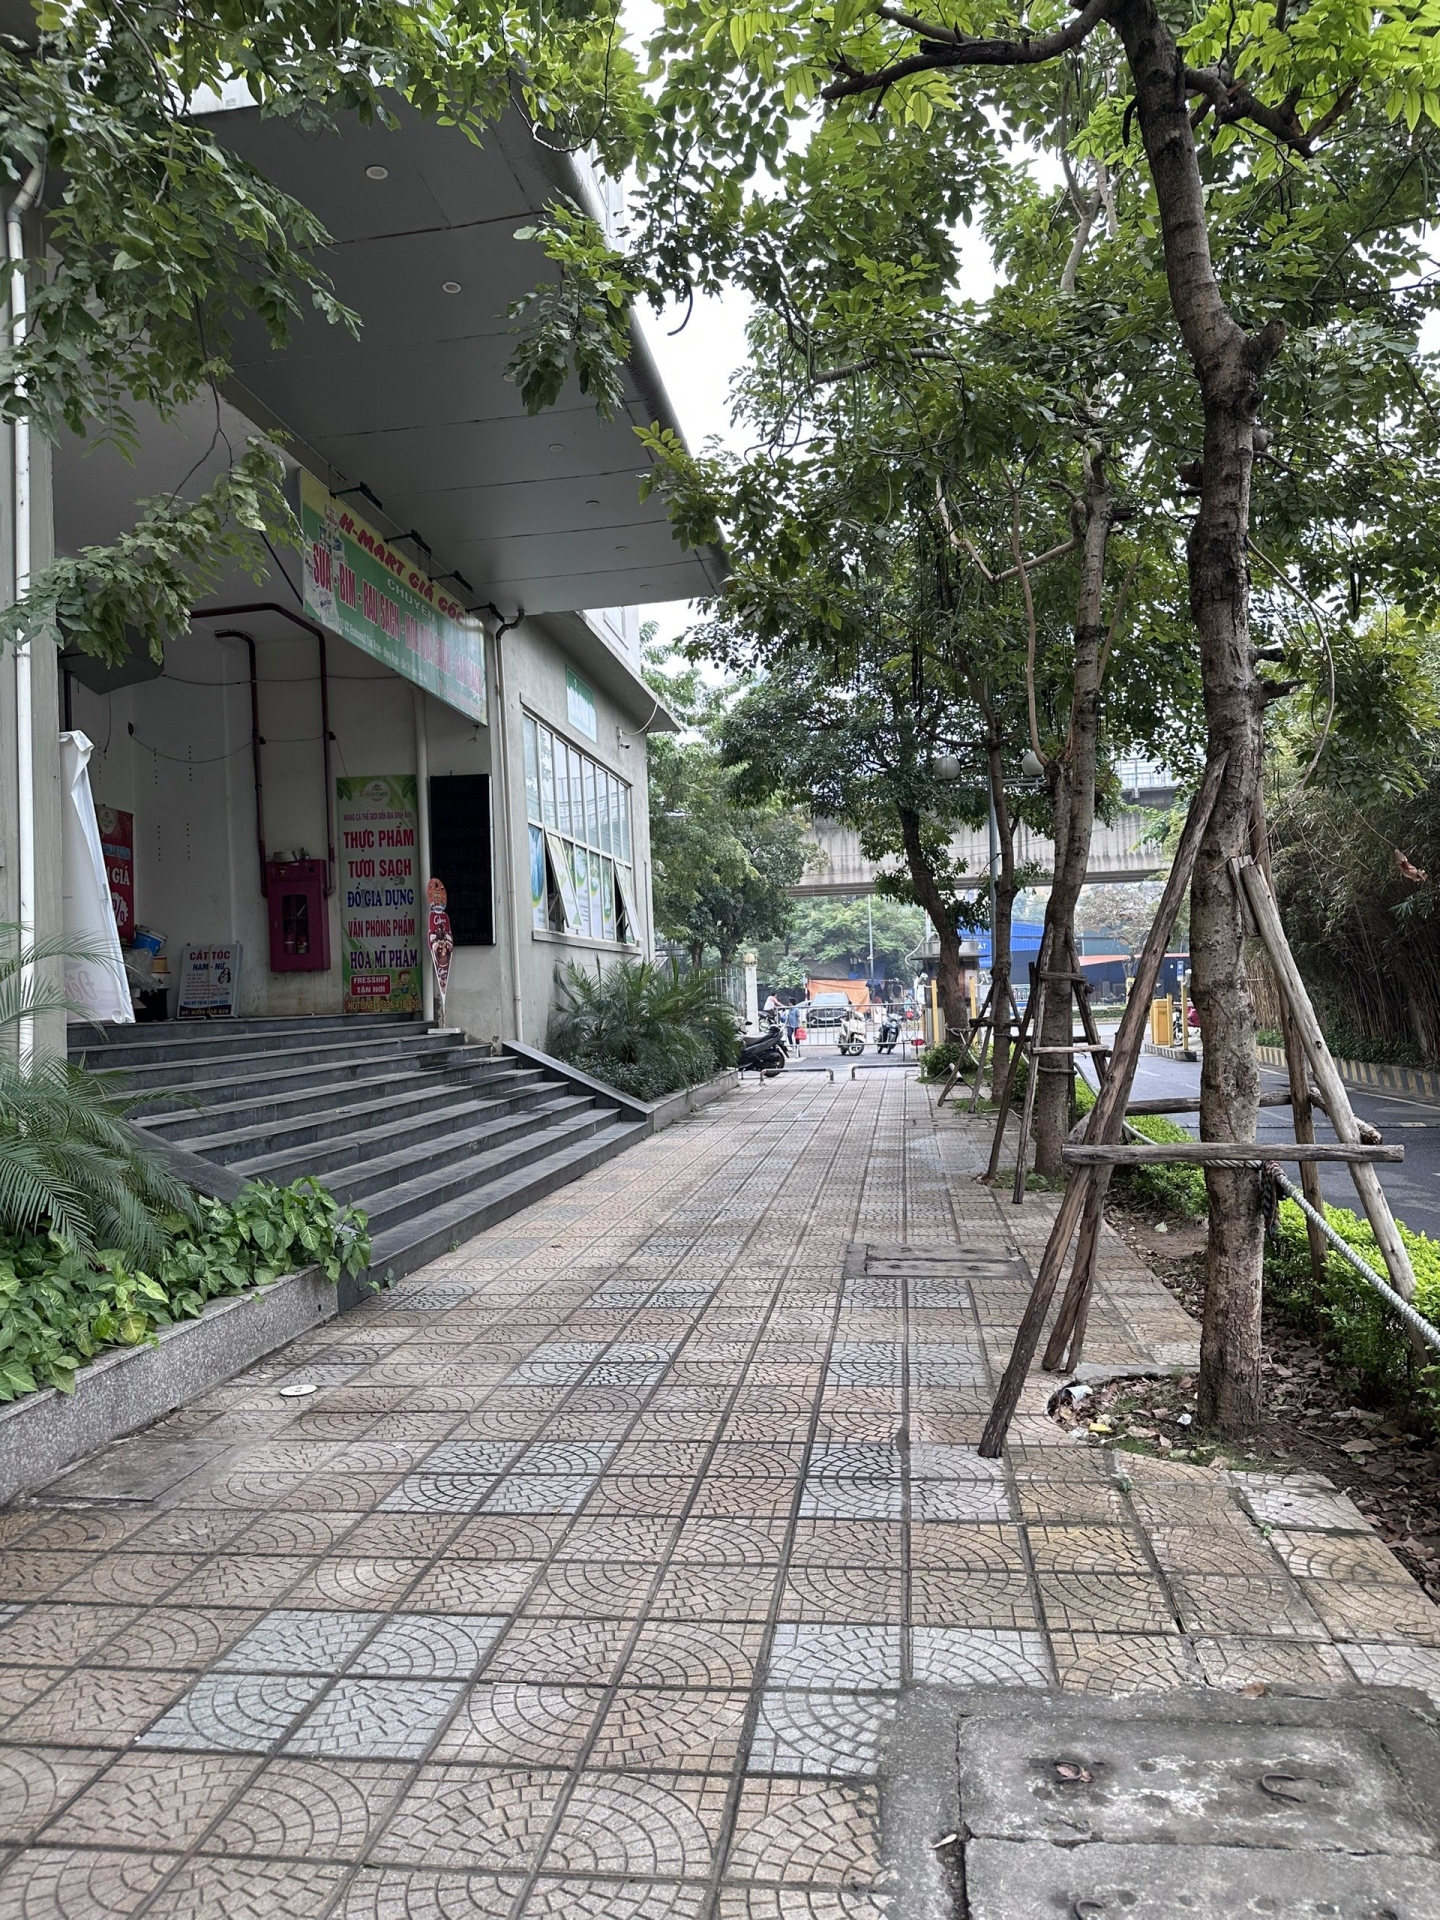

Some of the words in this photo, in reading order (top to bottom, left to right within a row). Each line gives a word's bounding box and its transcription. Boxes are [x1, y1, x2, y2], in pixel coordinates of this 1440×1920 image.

[338, 512, 406, 576] H-MART
[408, 572, 435, 603] GIÁ
[339, 564, 356, 612] BIM
[362, 579, 379, 626] RAU
[344, 828, 375, 852] THỰC
[379, 822, 415, 848] PHẨM
[112, 865, 130, 886] GIÁ
[348, 858, 375, 878] TƯƠI
[379, 858, 412, 881] SẠCH
[347, 882, 362, 908] ĐỒ
[364, 890, 383, 907] GIA
[385, 888, 415, 910] DỤNG
[348, 917, 364, 939] VĂN
[365, 915, 391, 938] PHÒNG
[393, 911, 415, 936] PHẨM
[190, 949, 209, 961] CẮT
[212, 949, 231, 960] TÓC
[192, 963, 209, 971] NAM
[215, 961, 226, 970] NỮ
[350, 945, 372, 970] HÓA
[374, 944, 386, 969] MĨ
[389, 938, 418, 968] PHẨM
[356, 985, 371, 994] TẬN
